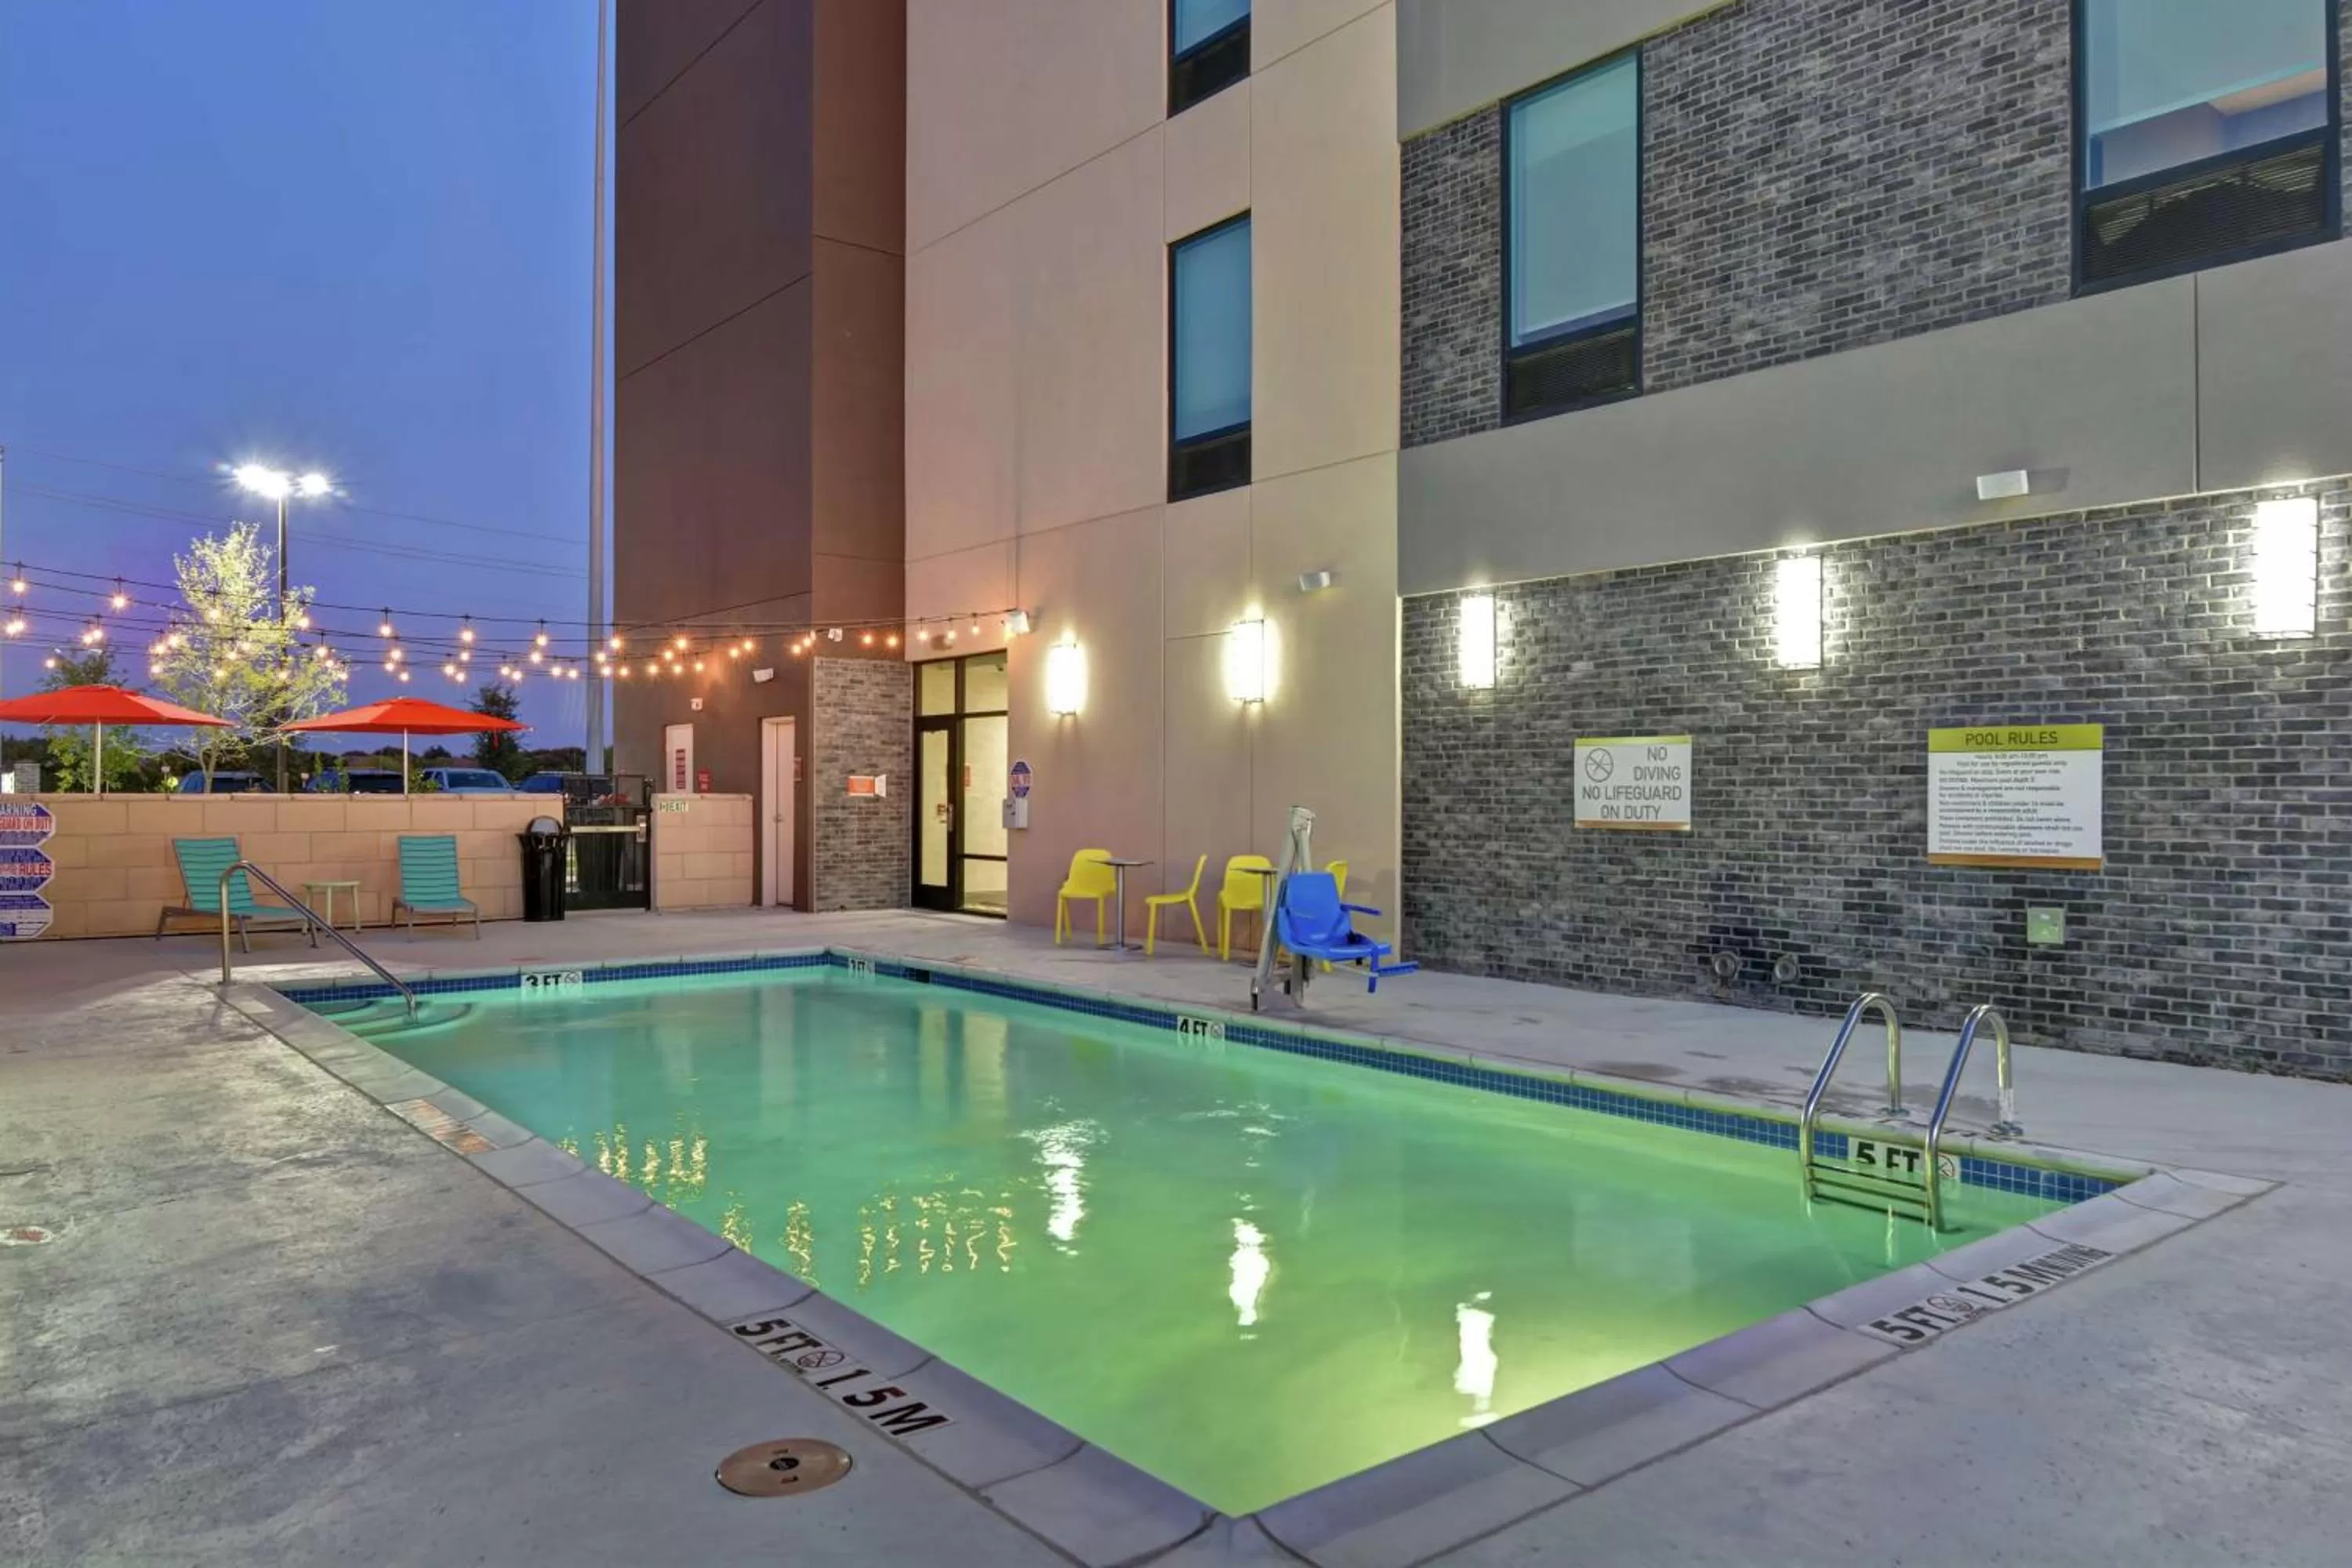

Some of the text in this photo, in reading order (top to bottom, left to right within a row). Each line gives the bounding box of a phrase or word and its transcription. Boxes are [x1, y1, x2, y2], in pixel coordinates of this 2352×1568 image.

[1965, 731, 2058, 746] POOL RULES
[1647, 746, 1668, 760] NO
[1633, 766, 1682, 781] DIVING
[1582, 785, 1682, 800] NO LIFEGUARD
[1600, 804, 1661, 819] ON DUTY
[19, 863, 51, 876] RULES
